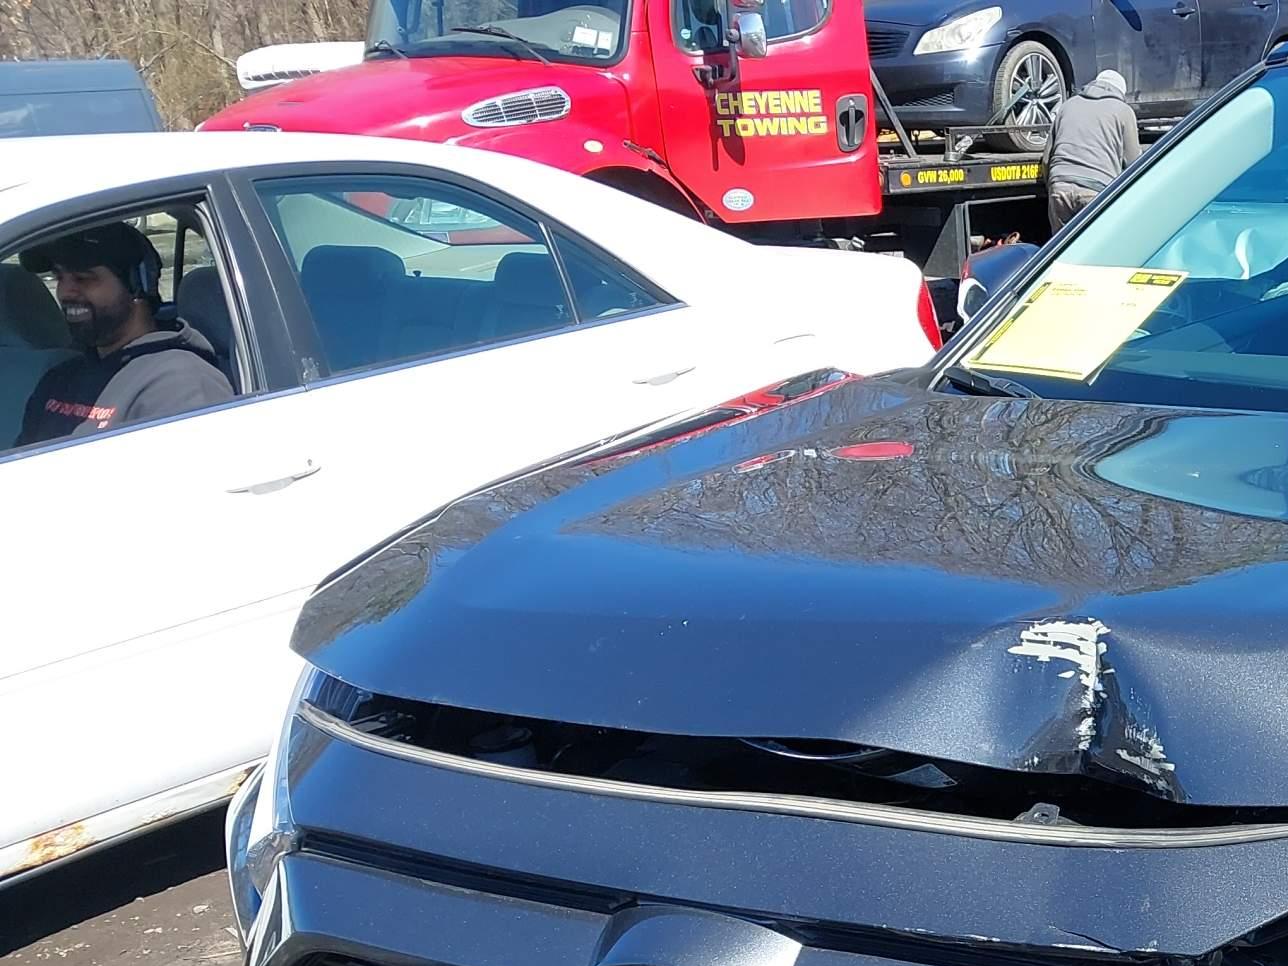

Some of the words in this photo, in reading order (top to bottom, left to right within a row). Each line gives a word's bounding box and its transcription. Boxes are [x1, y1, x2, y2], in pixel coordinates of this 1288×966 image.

[715, 89, 822, 115] CHEYENNE
[716, 116, 828, 137] TOWING
[917, 170, 937, 184] GVW
[938, 168, 964, 184] 26,000
[990, 164, 1020, 182] USDOT#
